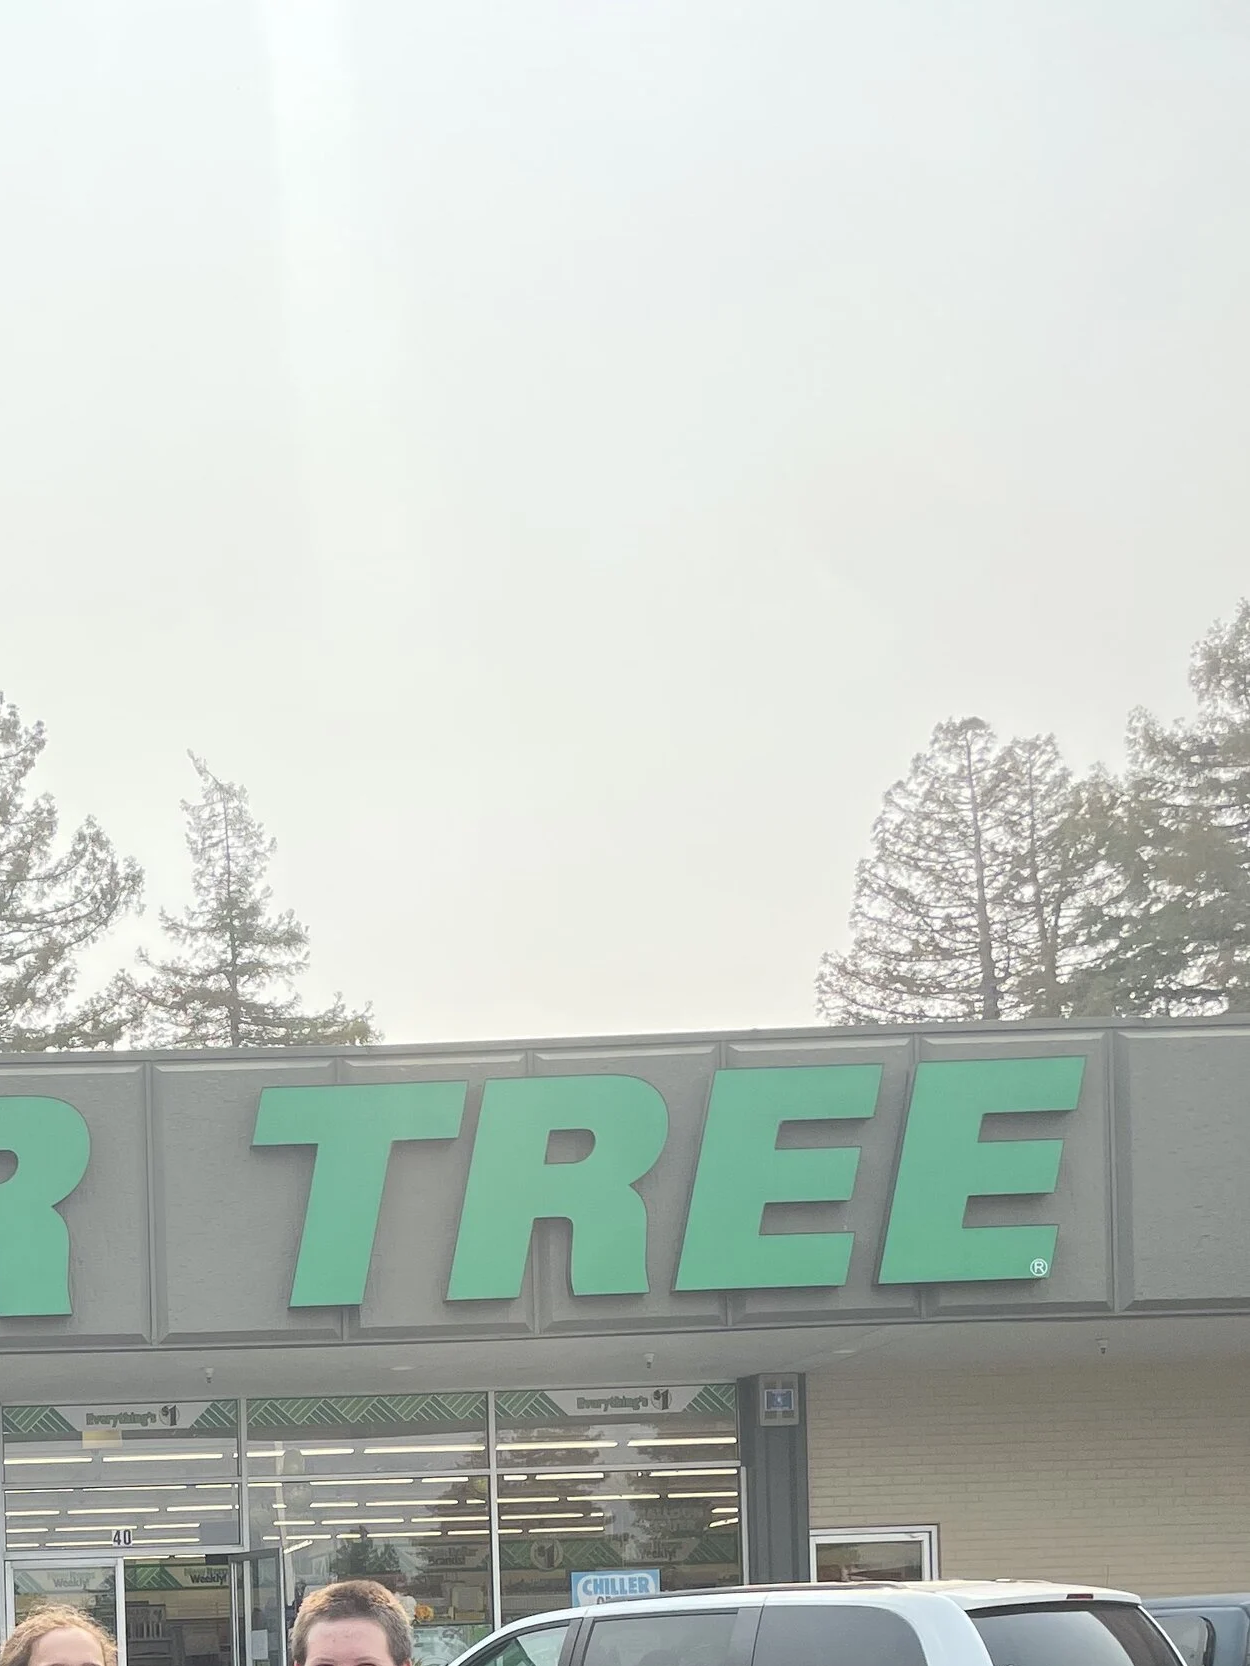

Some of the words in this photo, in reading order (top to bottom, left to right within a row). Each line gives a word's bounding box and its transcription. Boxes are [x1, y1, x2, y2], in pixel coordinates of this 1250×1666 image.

[250, 1055, 1088, 1308] TREE
[577, 1395, 649, 1412] Everything's
[86, 1411, 157, 1428] Everything's
[161, 1405, 178, 1426] $1
[113, 1529, 131, 1545] 40
[582, 1576, 650, 1596] CHILLER
